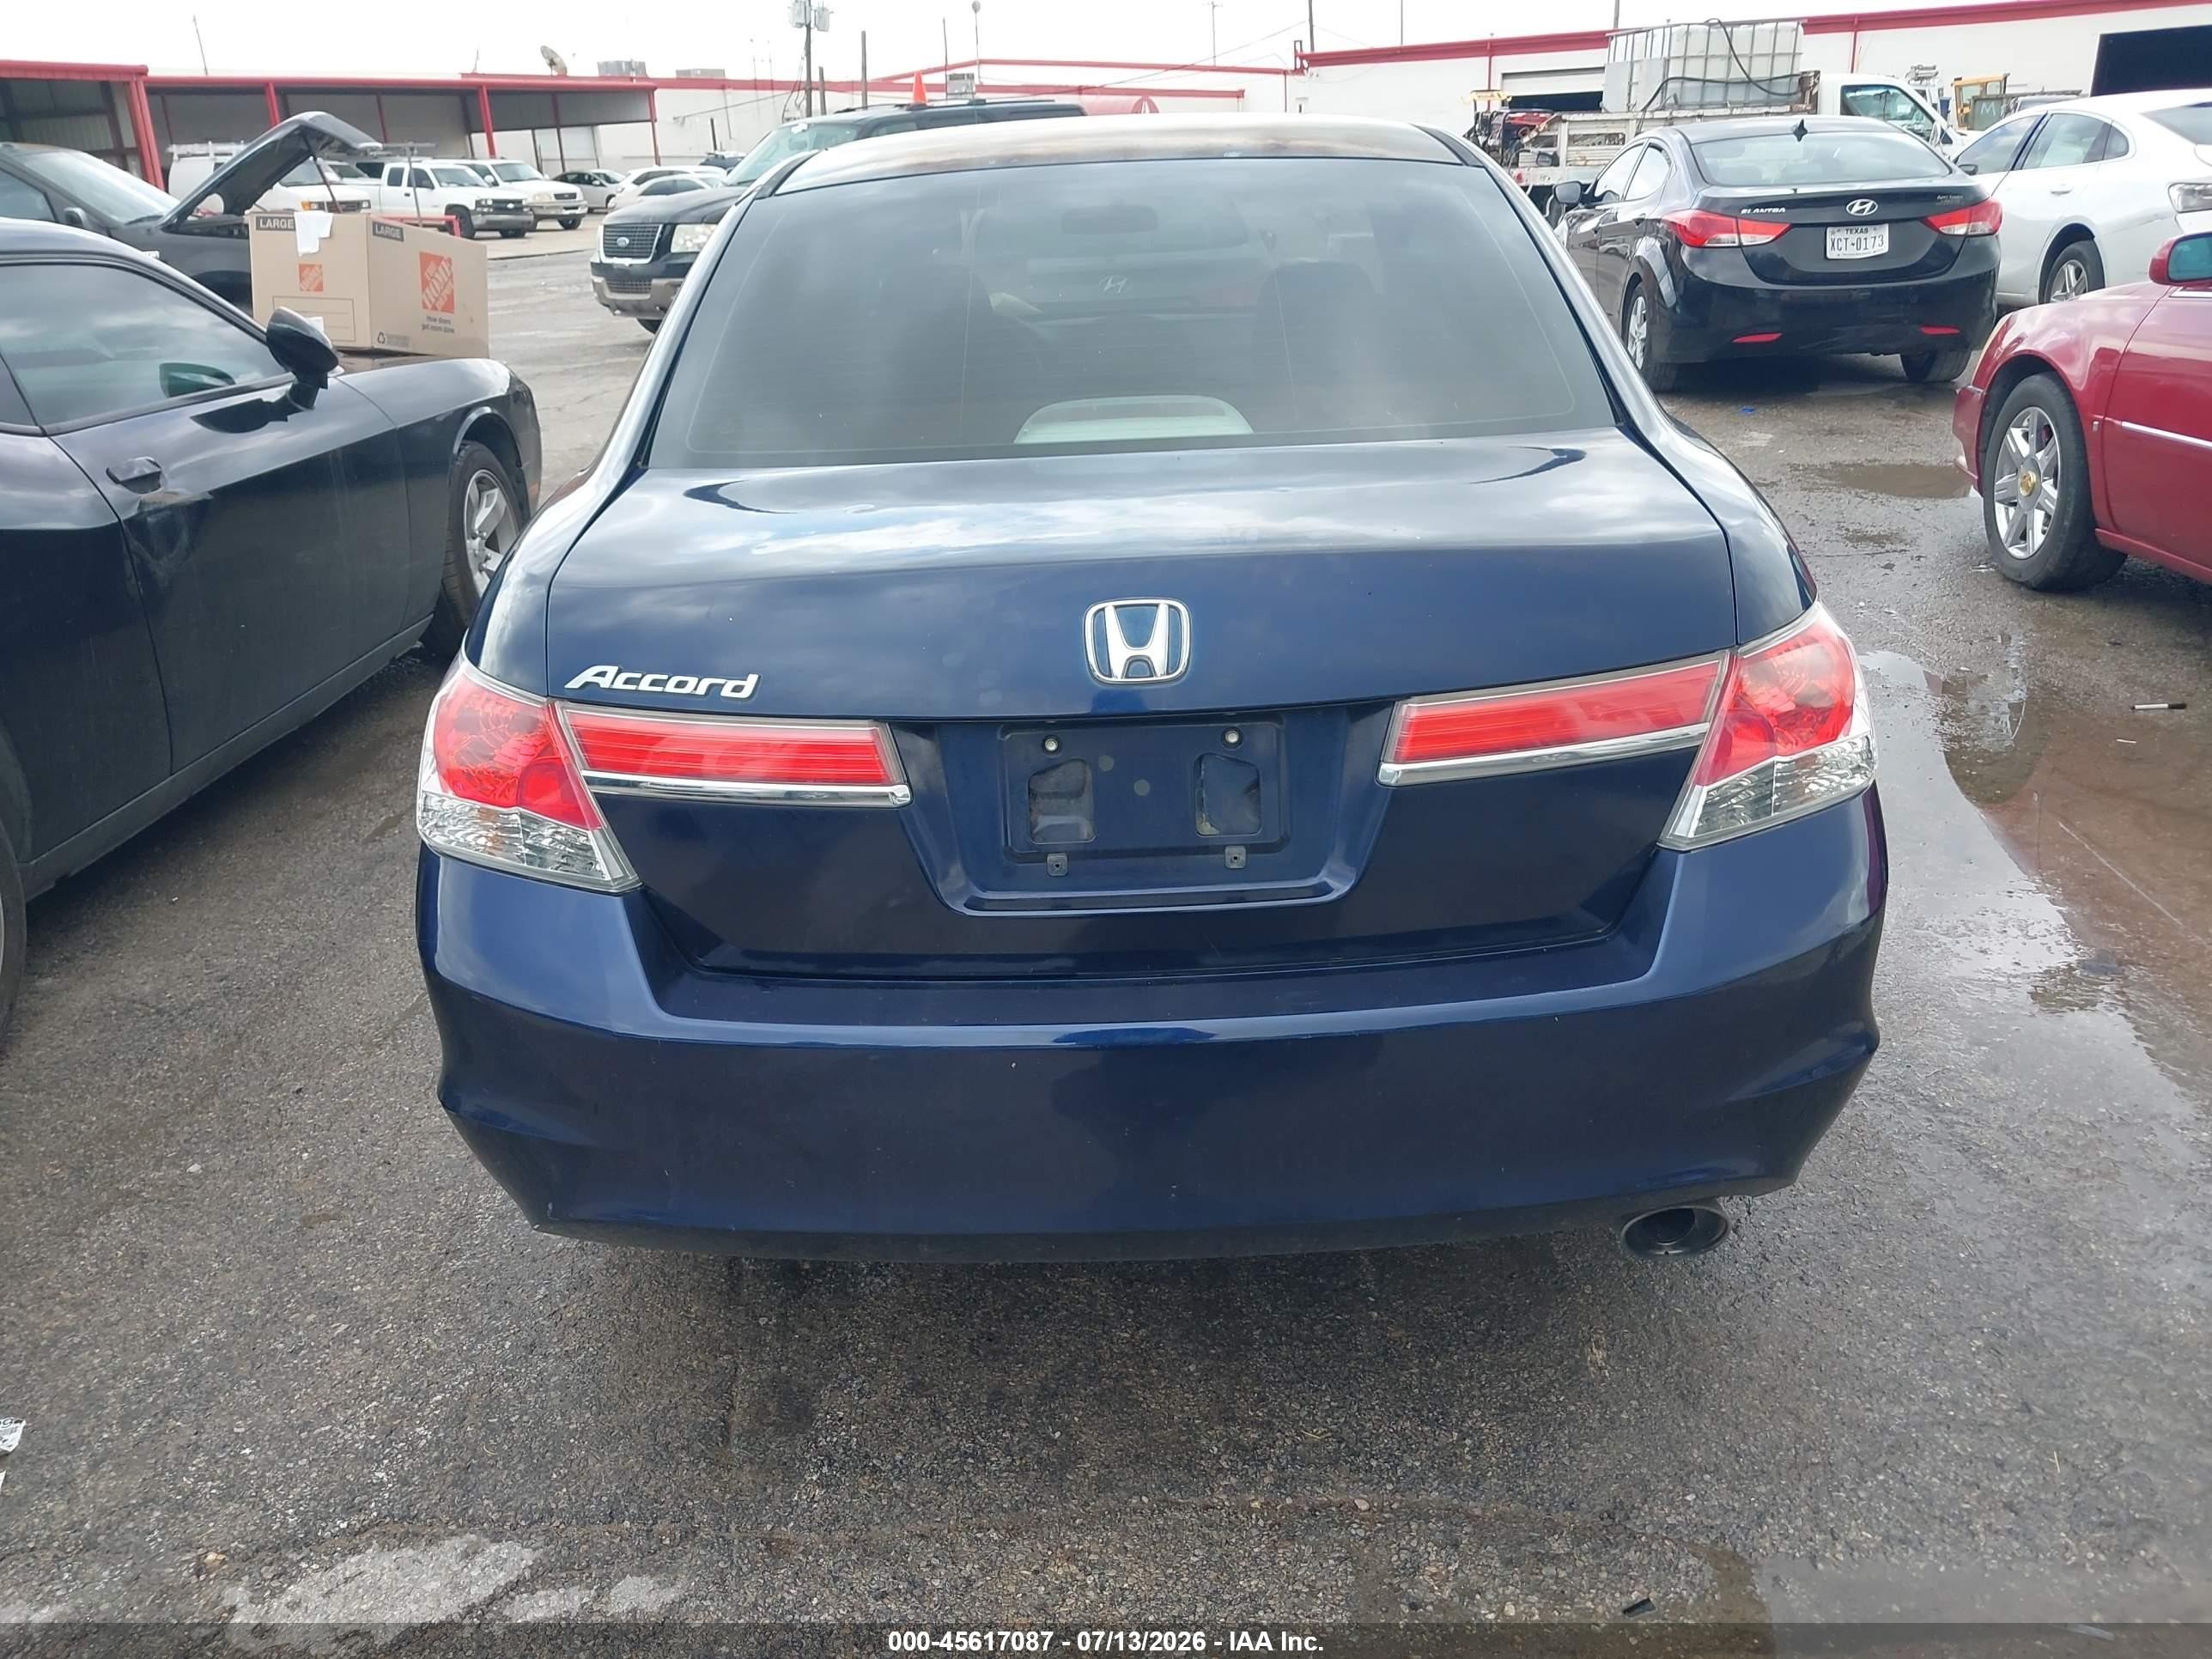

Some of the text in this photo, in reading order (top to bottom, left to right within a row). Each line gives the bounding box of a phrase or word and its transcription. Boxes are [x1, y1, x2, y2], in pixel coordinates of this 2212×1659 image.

[259, 218, 295, 229] LARGE
[375, 223, 401, 240] LARGE
[564, 665, 759, 699] Accord
